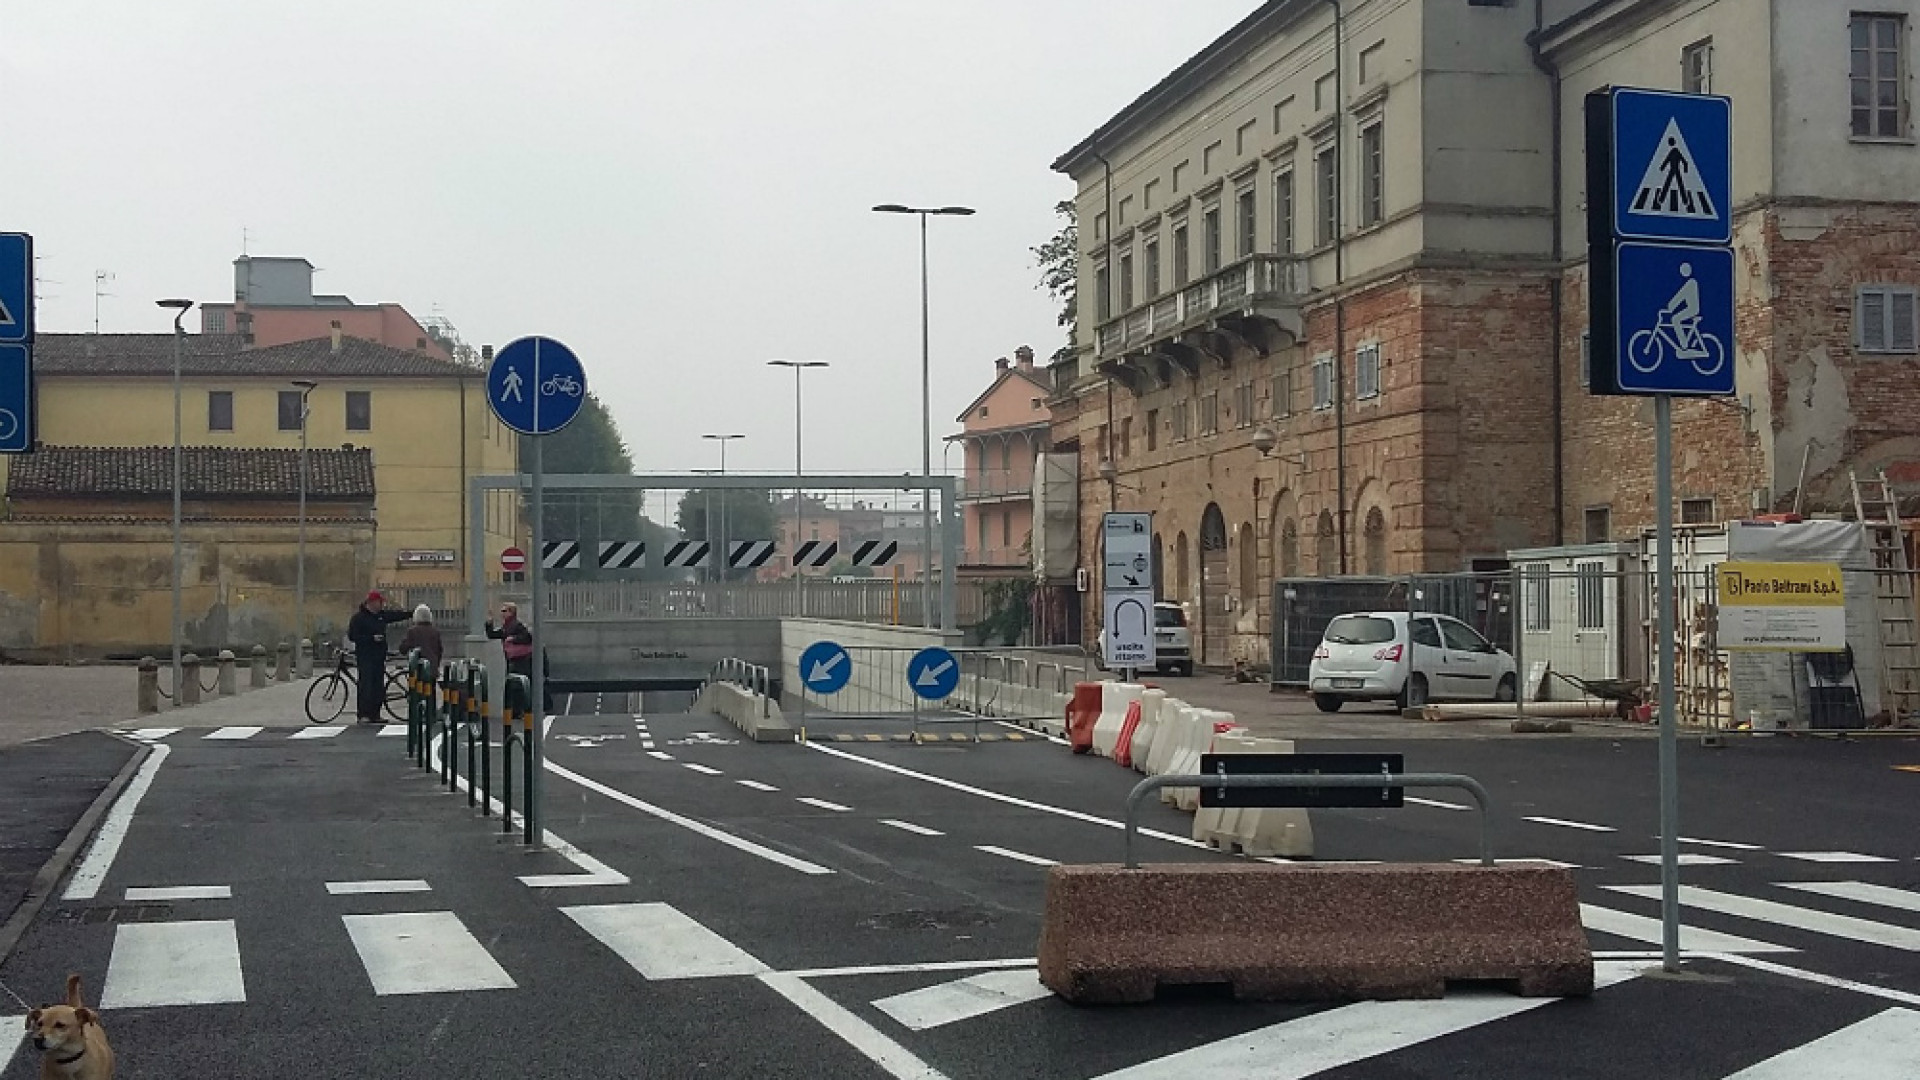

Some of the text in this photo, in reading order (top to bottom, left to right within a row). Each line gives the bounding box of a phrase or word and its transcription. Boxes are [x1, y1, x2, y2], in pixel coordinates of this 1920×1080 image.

[1744, 579, 1840, 597] Paolo Beltrami S.p.A.
